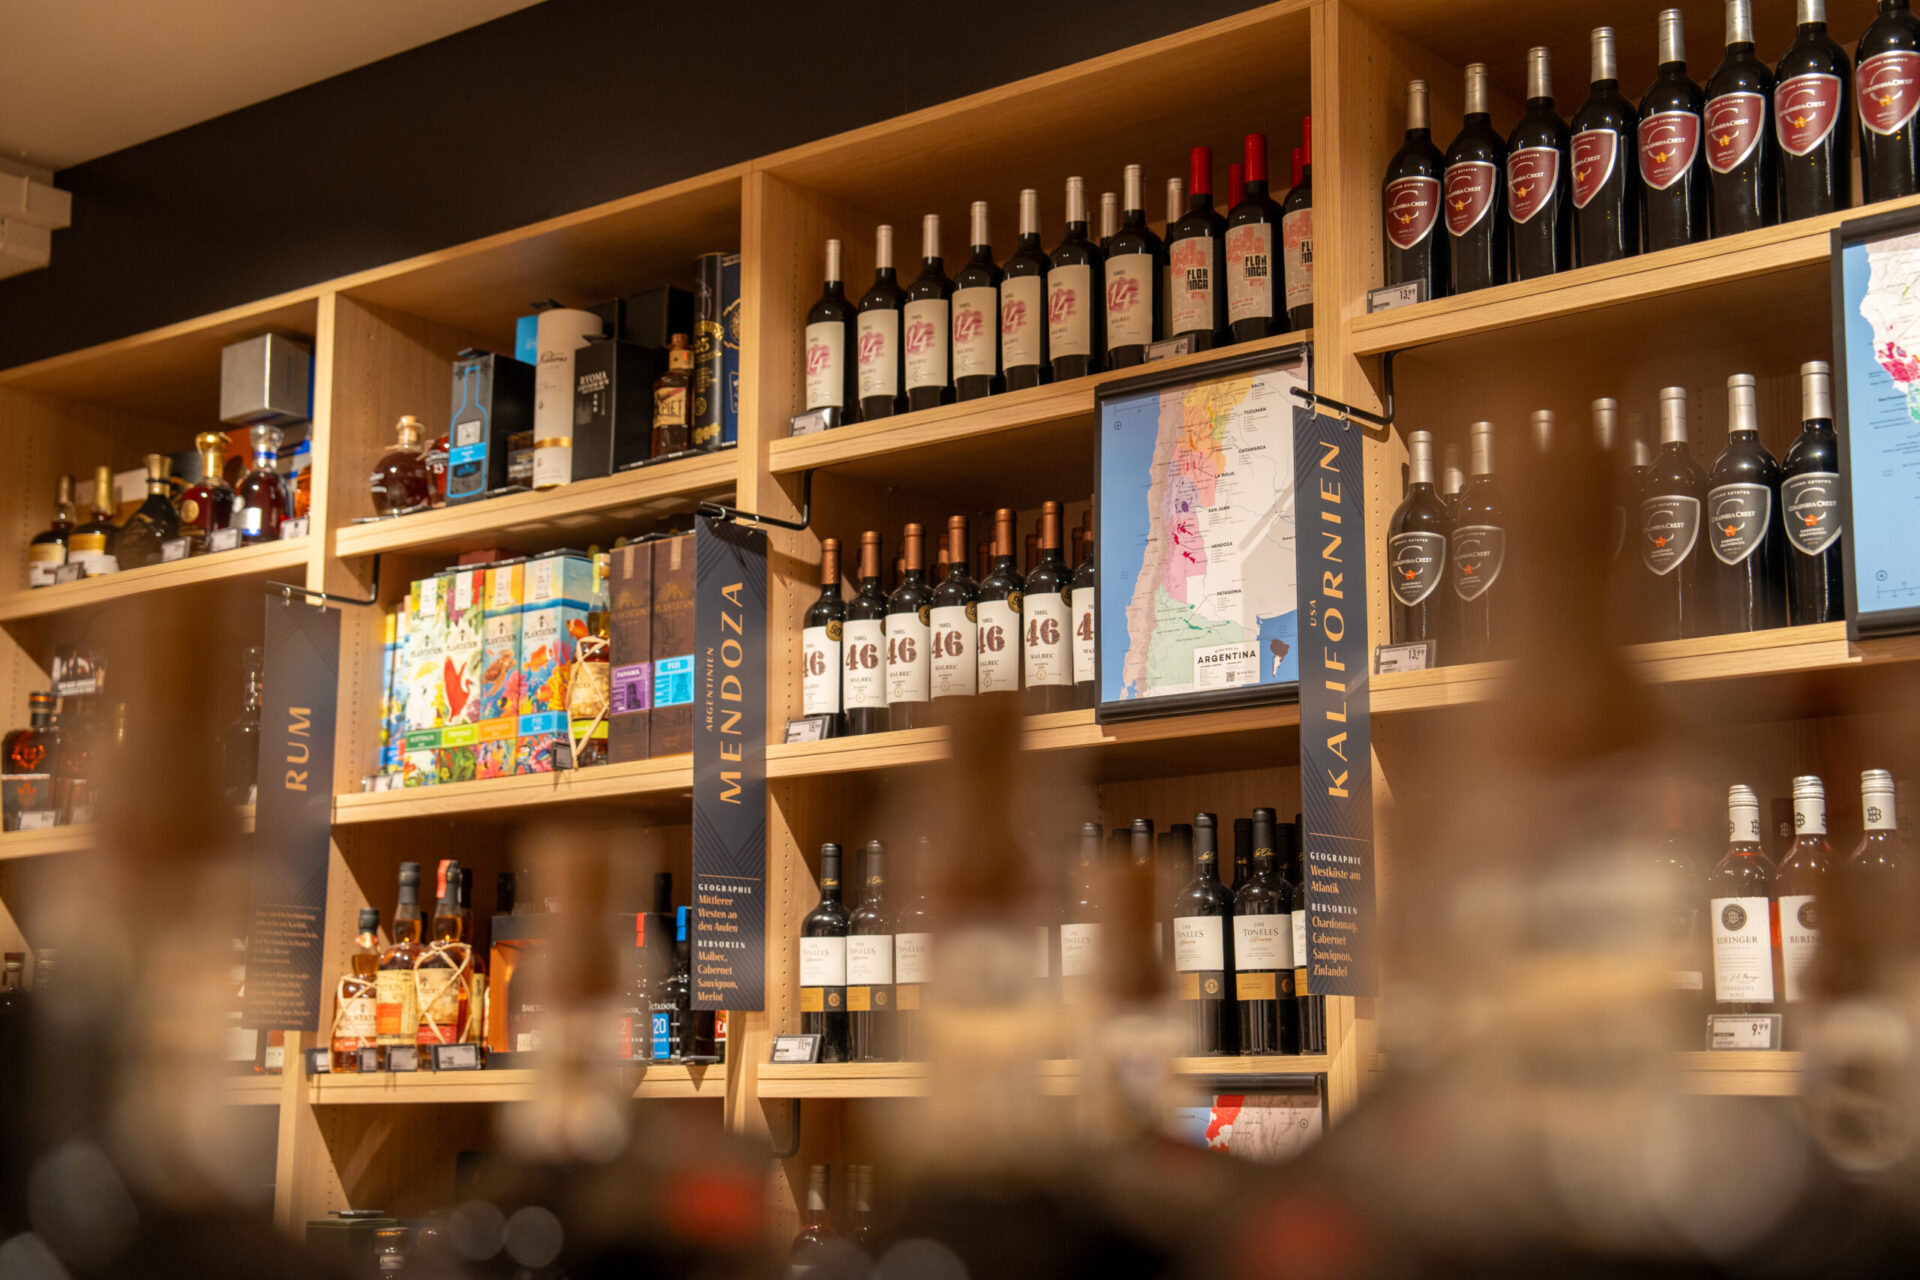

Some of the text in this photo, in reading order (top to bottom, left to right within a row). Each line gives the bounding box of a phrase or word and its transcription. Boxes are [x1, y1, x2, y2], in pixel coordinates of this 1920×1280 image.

[1245, 255, 1267, 267] FLOR
[1187, 268, 1208, 280] FLOR
[1110, 283, 1129, 309] 14
[1400, 288, 1417, 300] 13.99
[1050, 295, 1068, 321] 14
[1002, 306, 1017, 332] 14
[956, 316, 975, 340] 14
[908, 327, 927, 352] 14
[860, 336, 877, 361] 14
[807, 349, 822, 373] 14
[1238, 445, 1267, 454] CATAMARCA
[1788, 502, 1817, 512] COLUMBIA
[1211, 541, 1233, 549] MENDOZA
[1216, 588, 1242, 596] PATAGONIA
[1320, 441, 1349, 798] KALIFORNIEN
[524, 628, 557, 639] PLANTATION
[1026, 618, 1060, 647] 46
[932, 631, 963, 659] 46
[978, 625, 1005, 654] 46
[845, 644, 879, 671] 46
[887, 637, 917, 665] 46
[1197, 650, 1256, 665] ARGENTINA
[1408, 649, 1425, 660] 13.99
[616, 669, 641, 679] PANAMA
[705, 647, 714, 732] ARGENTINIEN
[720, 582, 743, 805] MENDOZA
[285, 706, 312, 791] RUM
[1310, 851, 1362, 865] GEOGRAPHIE
[1310, 864, 1361, 880] Westküste am
[698, 883, 752, 895] GEOGRAPHIE
[1311, 881, 1340, 894] Atlantik
[698, 894, 734, 906] Mittlerer
[698, 908, 738, 919] Westen an
[1311, 903, 1358, 915] REBSORTEN
[698, 921, 738, 933] den Anden
[1312, 915, 1359, 933] Chardonnay,
[1243, 928, 1279, 937] TONELES
[1312, 932, 1346, 946] Cabernet
[698, 940, 746, 949] REBSORTEN
[1716, 935, 1759, 944] BERINGER
[698, 951, 728, 962] Malbec,
[1313, 948, 1353, 963] Sauvignon,
[697, 964, 732, 975] Cabernet
[1314, 964, 1348, 977] Zinfandel
[697, 978, 738, 990] Sauvignon,
[697, 991, 724, 1002] Merlot
[653, 1018, 666, 1034] 20
[1752, 1023, 1769, 1036] 9.99
